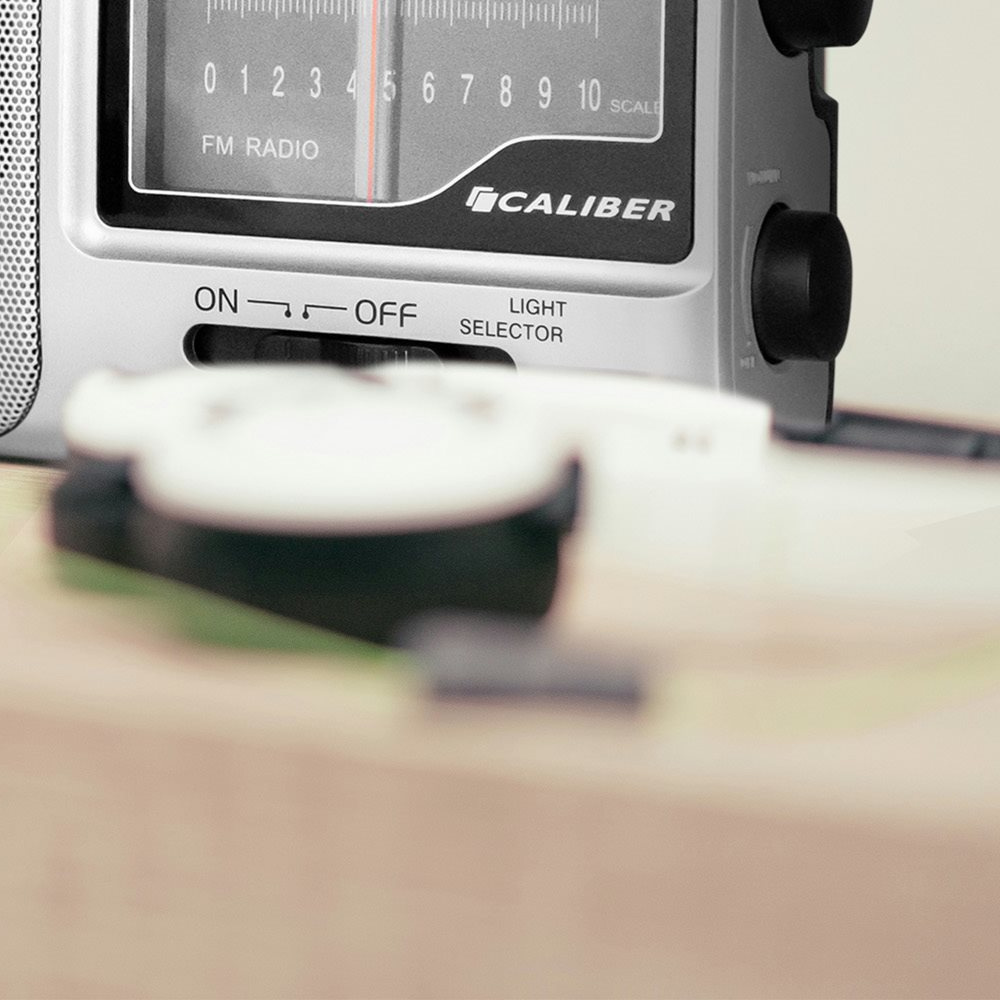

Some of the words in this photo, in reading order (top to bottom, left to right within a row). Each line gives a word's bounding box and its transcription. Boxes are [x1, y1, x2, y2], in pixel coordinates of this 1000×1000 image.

[204, 62, 217, 94] 0
[240, 64, 248, 95] 1
[272, 66, 285, 97] 2
[310, 67, 321, 99] 3
[346, 69, 356, 100] 4
[383, 70, 396, 102] 5
[423, 71, 435, 104] 6
[460, 73, 474, 105] 7
[500, 74, 512, 107] 8
[539, 76, 552, 109] 9
[578, 78, 601, 112] 10
[202, 135, 234, 155] FM
[246, 137, 319, 160] RADIO
[498, 191, 676, 221] CALIBER
[194, 286, 239, 314] ON
[354, 299, 418, 328] OFF
[509, 297, 567, 318] LIGHT
[459, 318, 564, 343] SELECTOR
